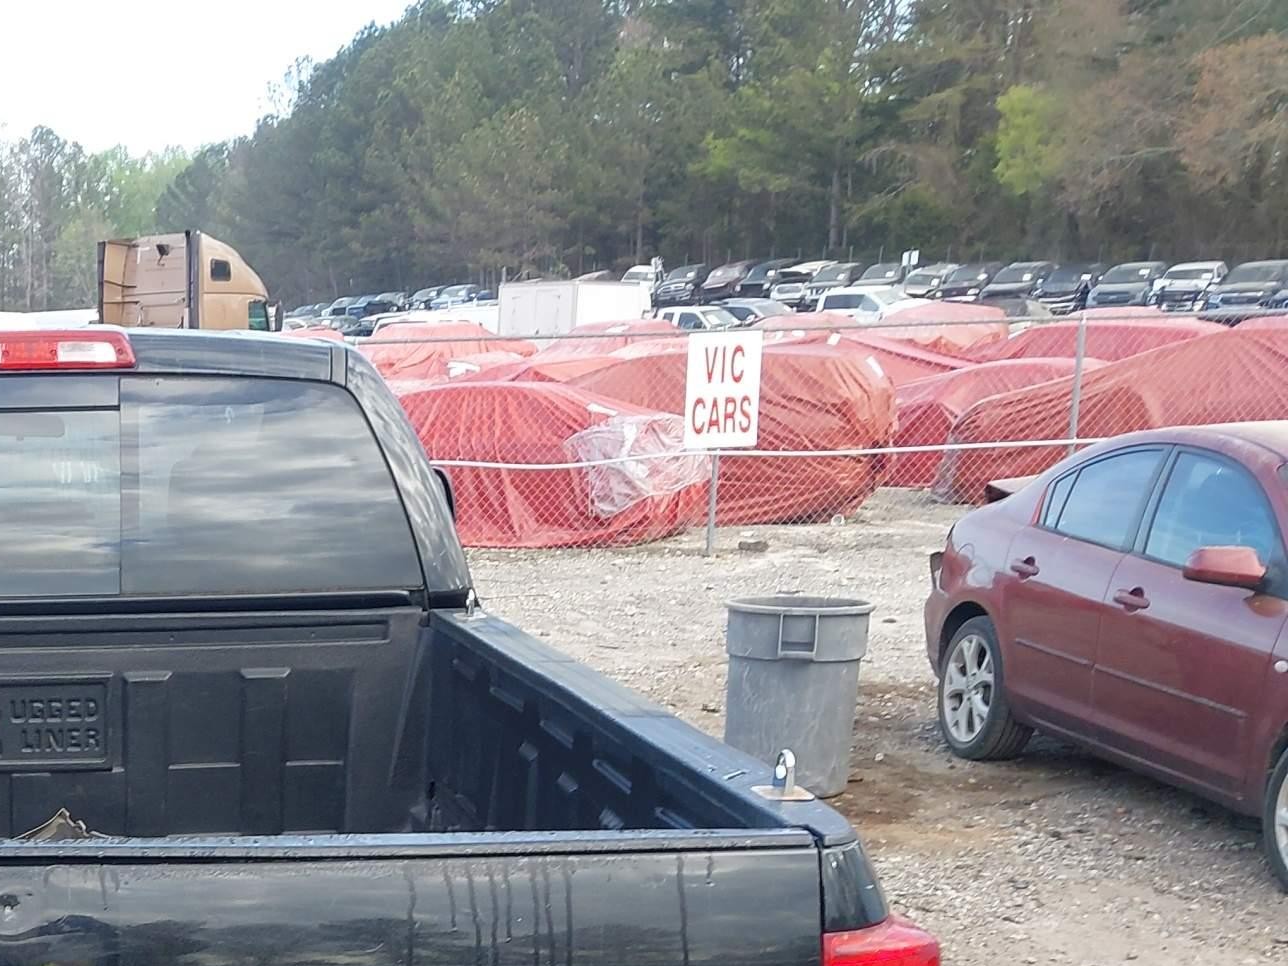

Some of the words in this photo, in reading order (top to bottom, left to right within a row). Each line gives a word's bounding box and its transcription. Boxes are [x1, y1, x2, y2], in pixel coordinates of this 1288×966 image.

[704, 344, 746, 384] VIC
[691, 395, 753, 436] CARS
[19, 727, 102, 754] LINER
